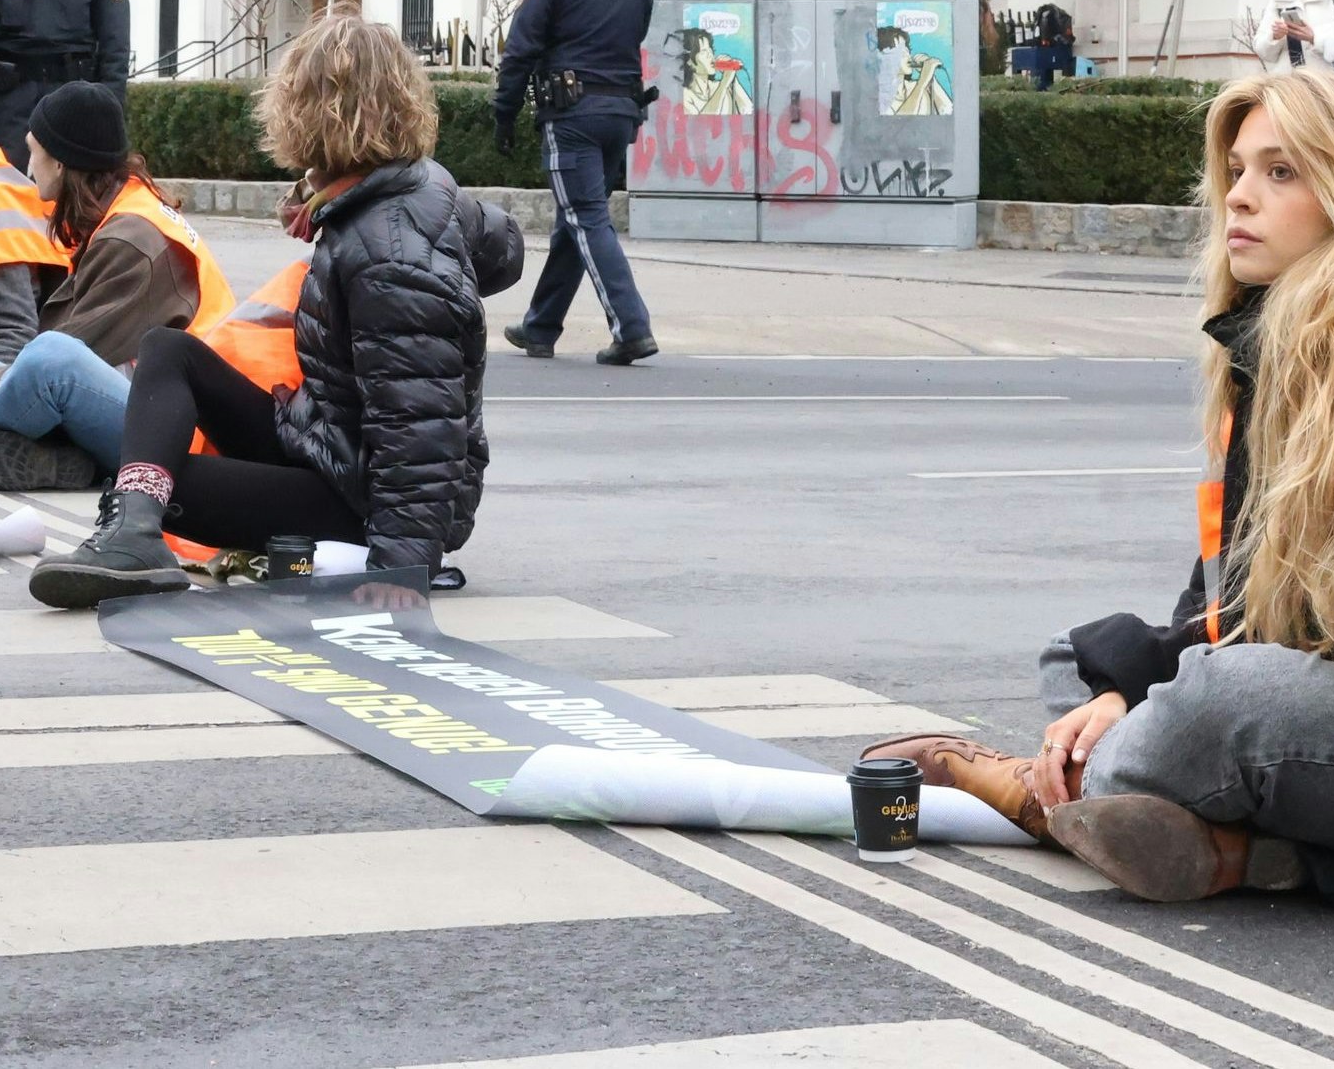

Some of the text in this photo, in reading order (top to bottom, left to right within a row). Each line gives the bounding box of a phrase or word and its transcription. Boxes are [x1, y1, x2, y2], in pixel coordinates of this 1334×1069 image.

[310, 612, 454, 663] KEINE
[396, 662, 566, 698] NEUEN
[251, 668, 388, 695] SIND
[326, 694, 537, 756] GENUG!
